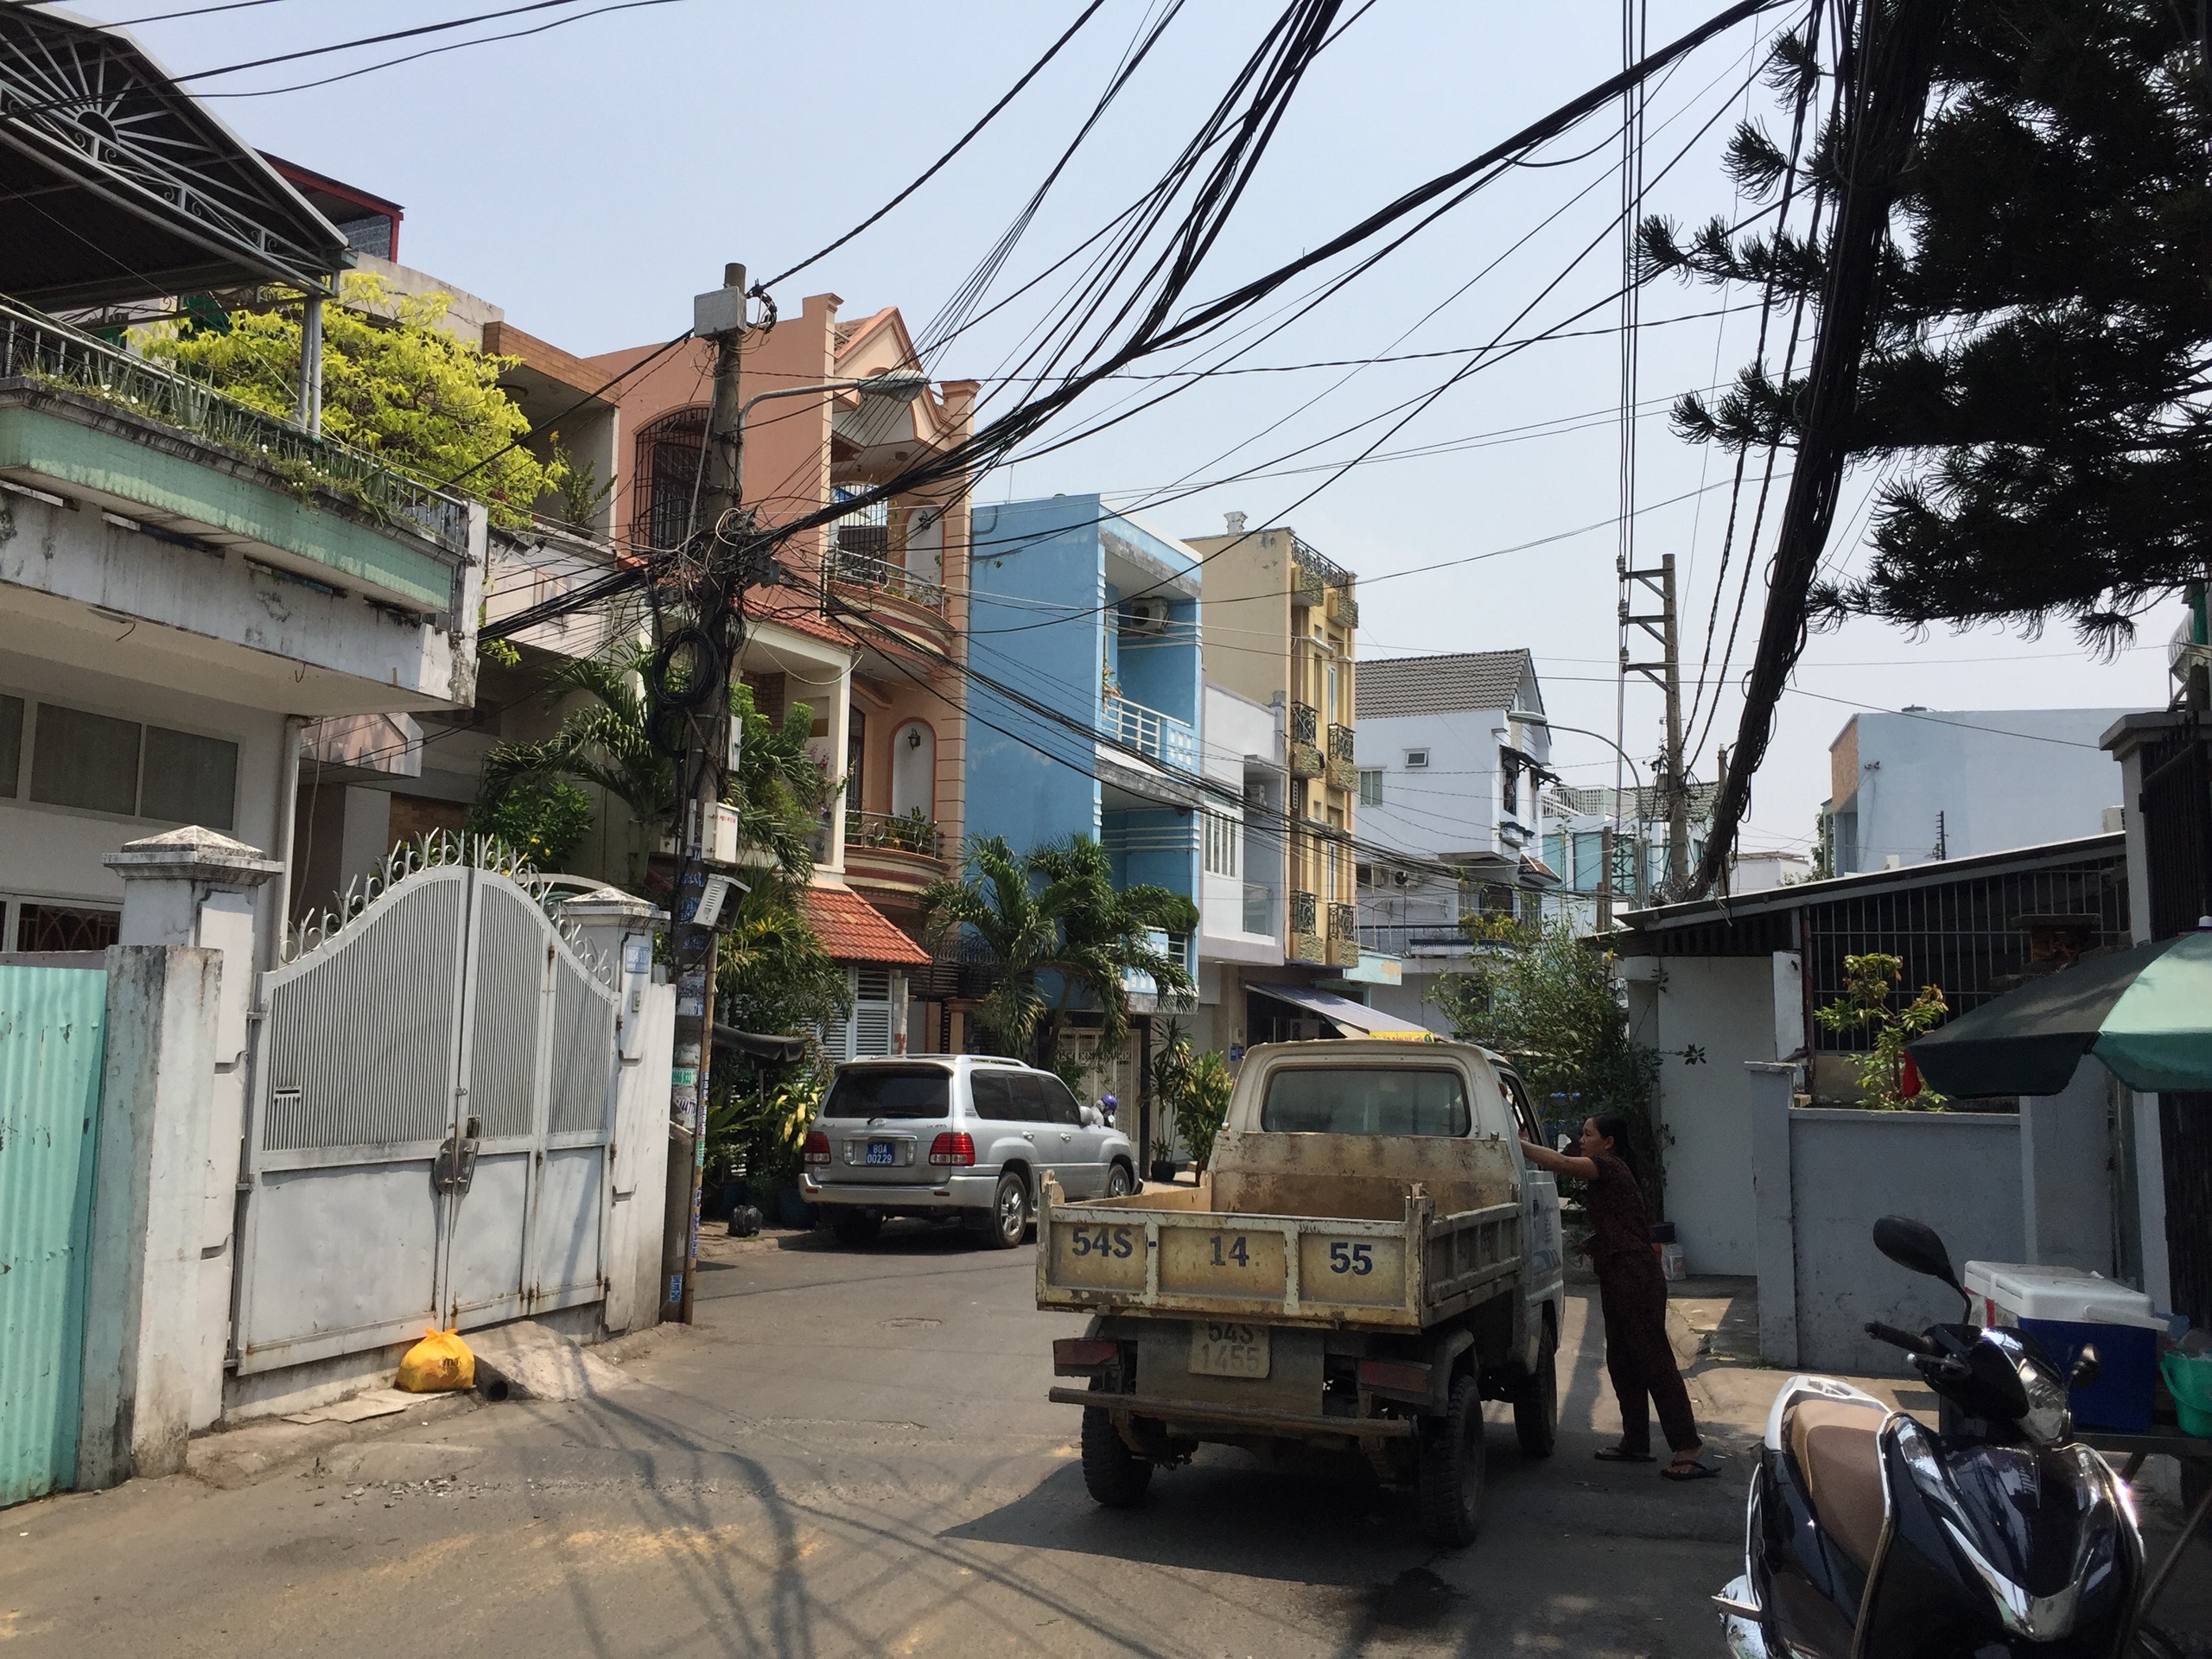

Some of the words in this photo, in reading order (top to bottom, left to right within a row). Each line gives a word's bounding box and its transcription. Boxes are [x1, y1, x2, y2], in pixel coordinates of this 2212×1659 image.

[867, 1154, 893, 1164] 00229
[873, 1144, 887, 1154] 80A
[1210, 1236, 1250, 1268] 14
[1329, 1242, 1373, 1276] 55
[1208, 1321, 1255, 1344] 54S
[1202, 1343, 1261, 1372] 1455
